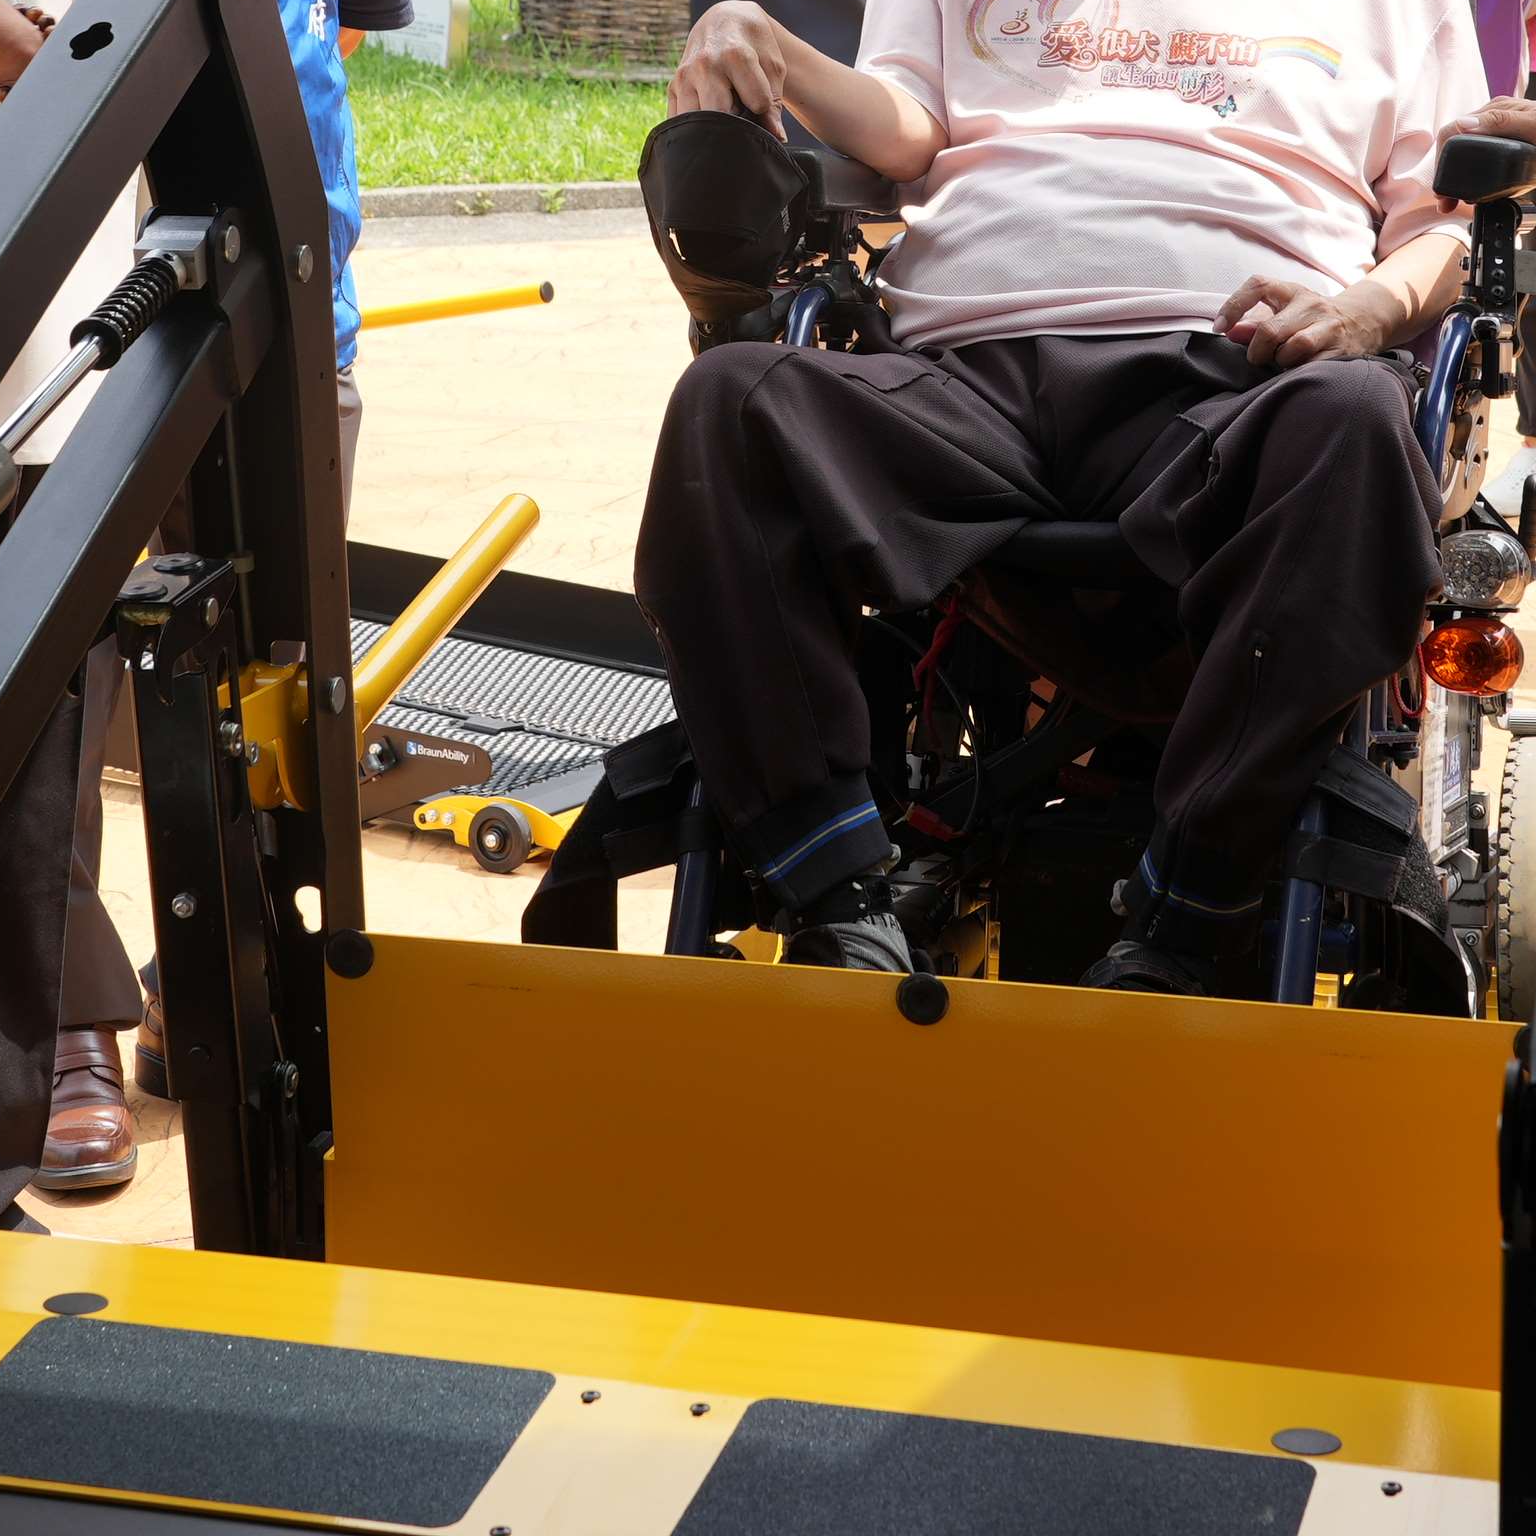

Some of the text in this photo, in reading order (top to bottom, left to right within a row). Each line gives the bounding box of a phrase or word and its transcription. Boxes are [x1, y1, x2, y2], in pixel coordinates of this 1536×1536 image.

[1038, 17, 1160, 71] 愛很大
[417, 744, 469, 765] BraunAbility
